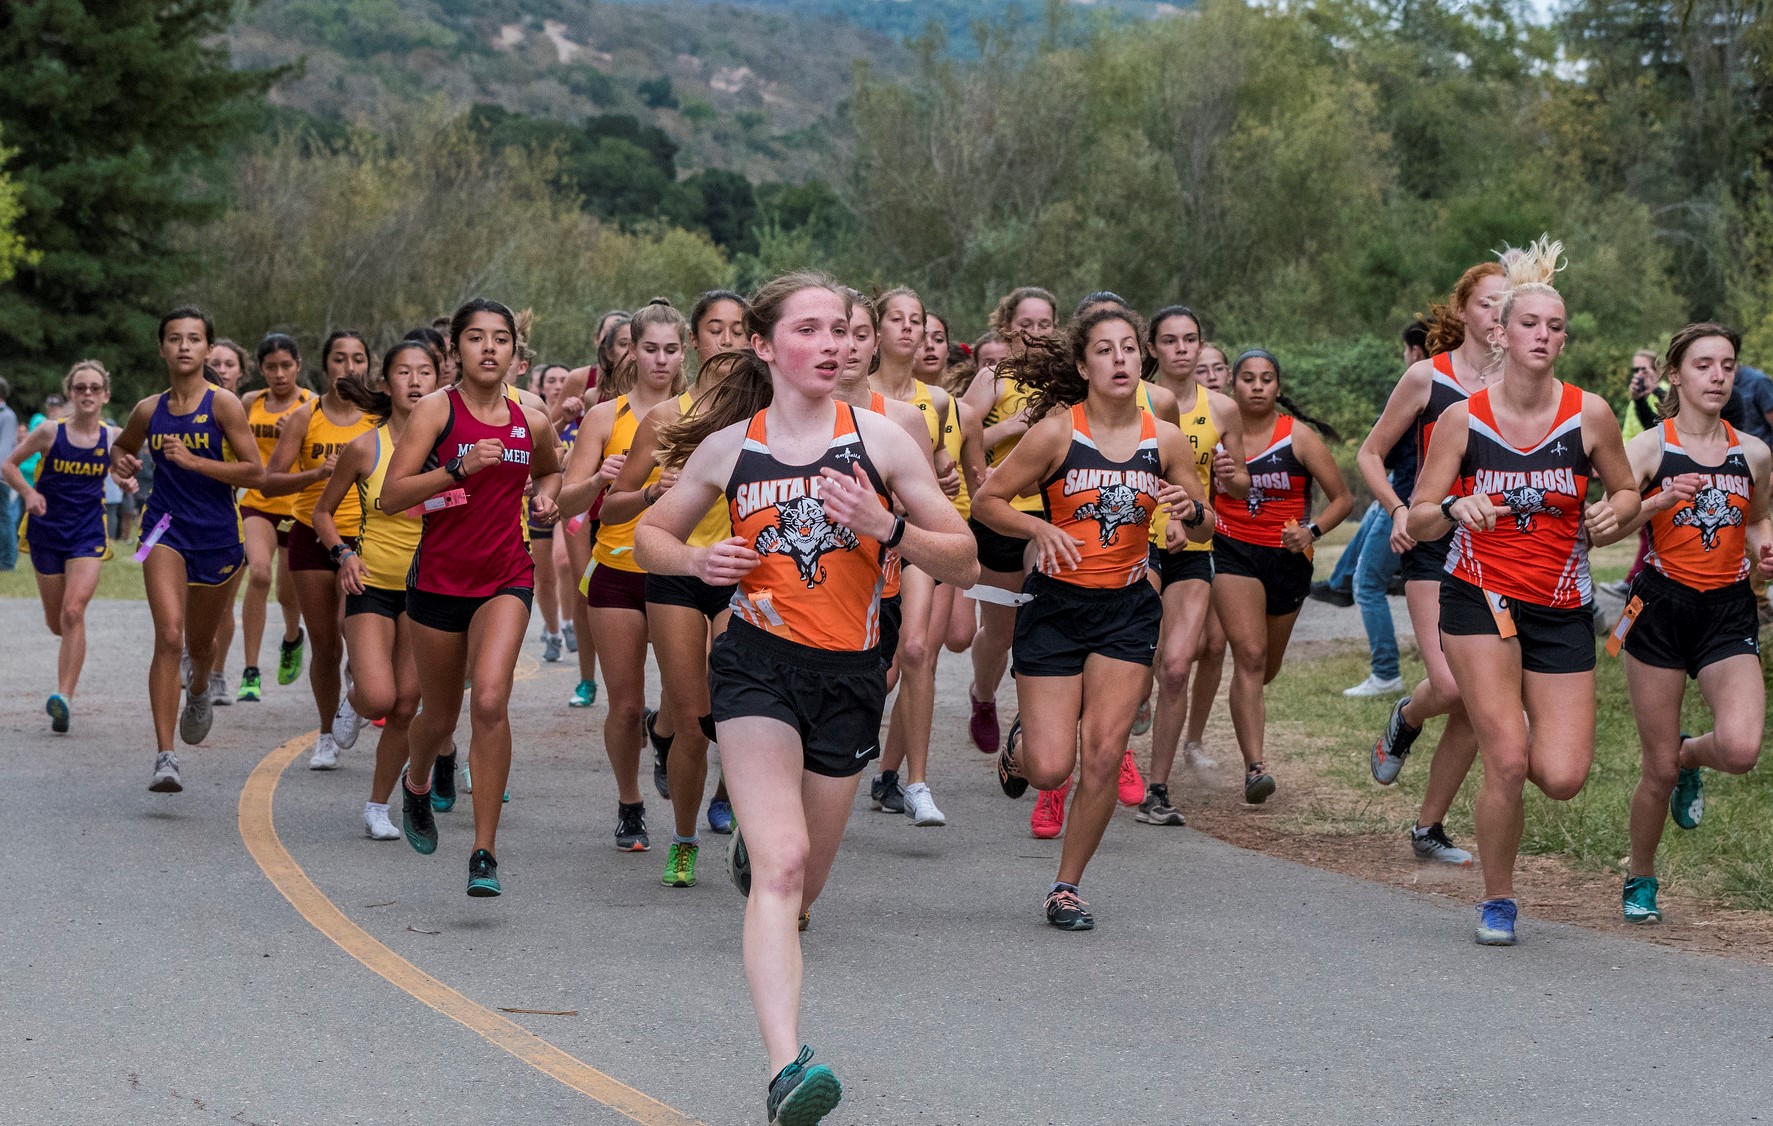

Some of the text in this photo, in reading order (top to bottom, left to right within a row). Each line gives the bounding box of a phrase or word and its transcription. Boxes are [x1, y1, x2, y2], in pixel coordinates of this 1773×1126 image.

[151, 432, 209, 450] UAH
[311, 442, 348, 459] PIN
[53, 459, 104, 476] UKIAH
[1063, 468, 1123, 497] SANTA
[1251, 471, 1291, 491] ROSA
[1473, 467, 1578, 497] SANTA ROSA
[1715, 473, 1751, 501] ROSA
[736, 476, 808, 520] SANTA
